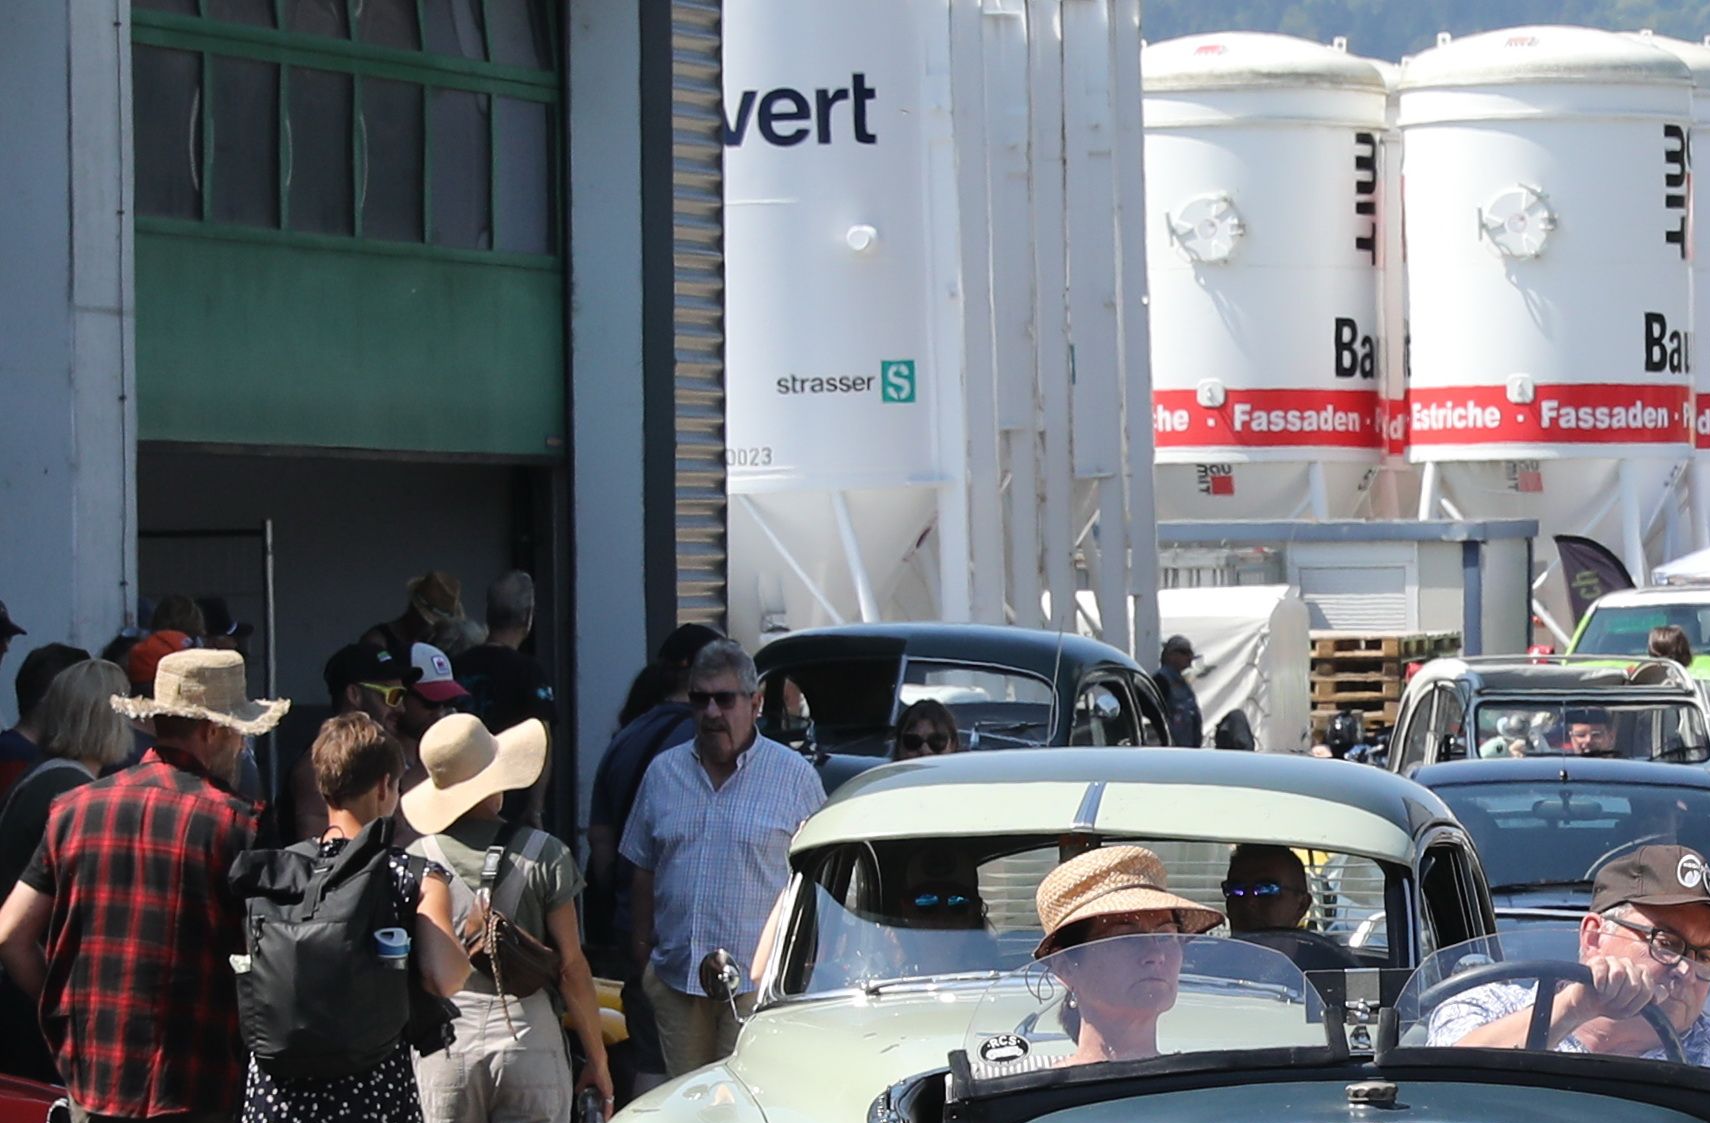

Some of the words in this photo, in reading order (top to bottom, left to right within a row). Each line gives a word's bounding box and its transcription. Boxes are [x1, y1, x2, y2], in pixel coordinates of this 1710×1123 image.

[776, 374, 875, 394] strasser
[1232, 402, 1361, 432] Fassaden
[1411, 401, 1501, 431] Estriche
[1540, 400, 1669, 430] Fassaden
[988, 1034, 1018, 1049] RCS
